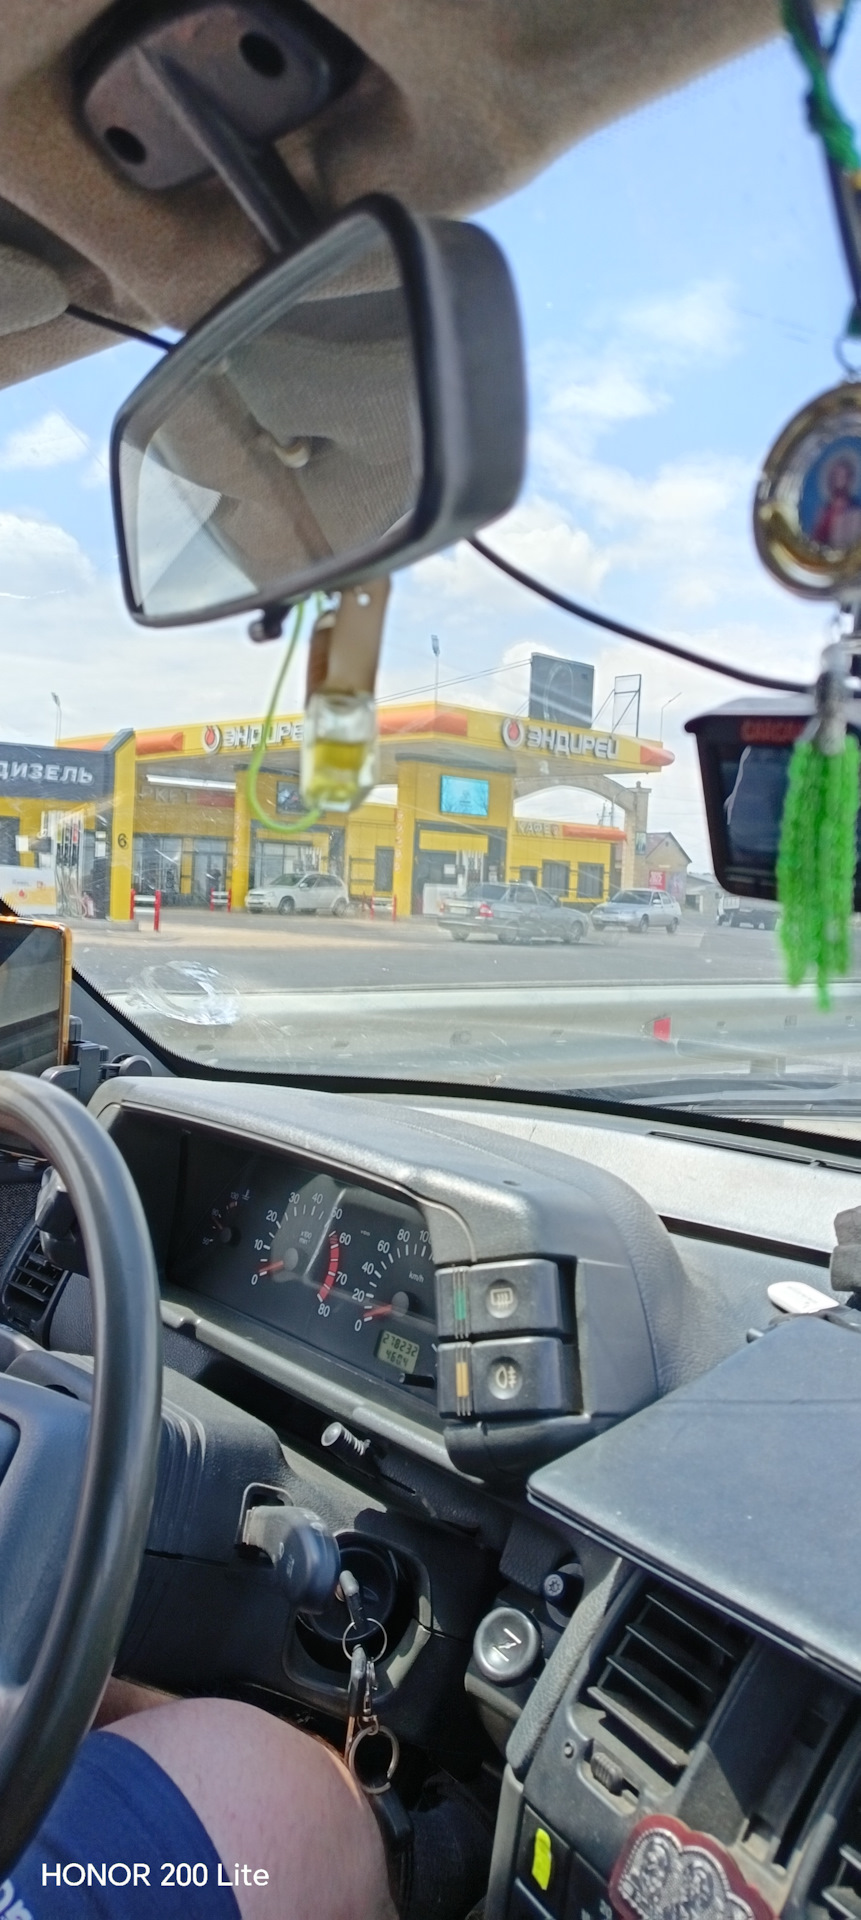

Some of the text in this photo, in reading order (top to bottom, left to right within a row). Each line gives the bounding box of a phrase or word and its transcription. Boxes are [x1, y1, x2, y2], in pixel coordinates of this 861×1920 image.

[117, 833, 129, 849] 6
[288, 1191, 301, 1205] 30
[312, 1192, 324, 1205] 40
[265, 1209, 278, 1223] 20
[339, 1232, 352, 1246] 60
[396, 1228, 411, 1243] 80
[253, 1239, 264, 1251] 10
[376, 1239, 391, 1254] 60
[361, 1261, 375, 1275] 40
[250, 1274, 259, 1286] 0
[335, 1271, 348, 1286] 70
[408, 1271, 425, 1284] km/h
[351, 1287, 366, 1303] 20
[317, 1303, 331, 1318] 80
[354, 1319, 363, 1332] 0
[382, 1333, 418, 1358] 278232
